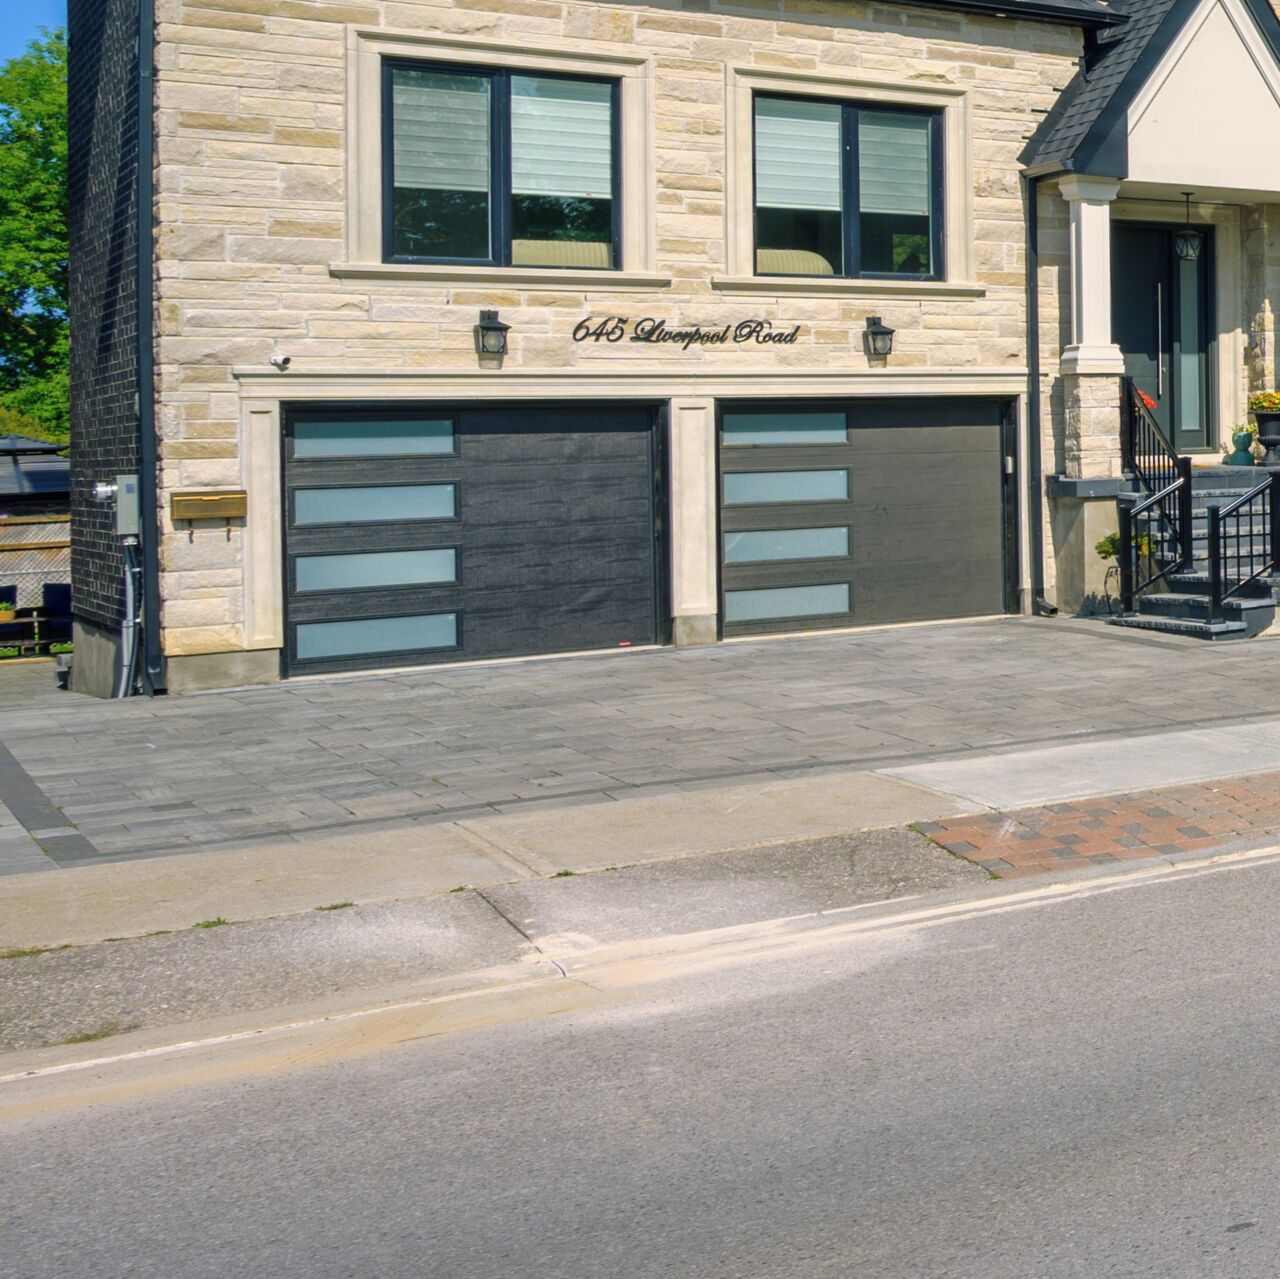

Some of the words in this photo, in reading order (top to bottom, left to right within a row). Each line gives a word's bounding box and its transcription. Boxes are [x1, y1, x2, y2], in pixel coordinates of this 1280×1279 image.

[572, 317, 627, 342] 645
[629, 317, 729, 350] Liverpool
[733, 320, 799, 344] Road
